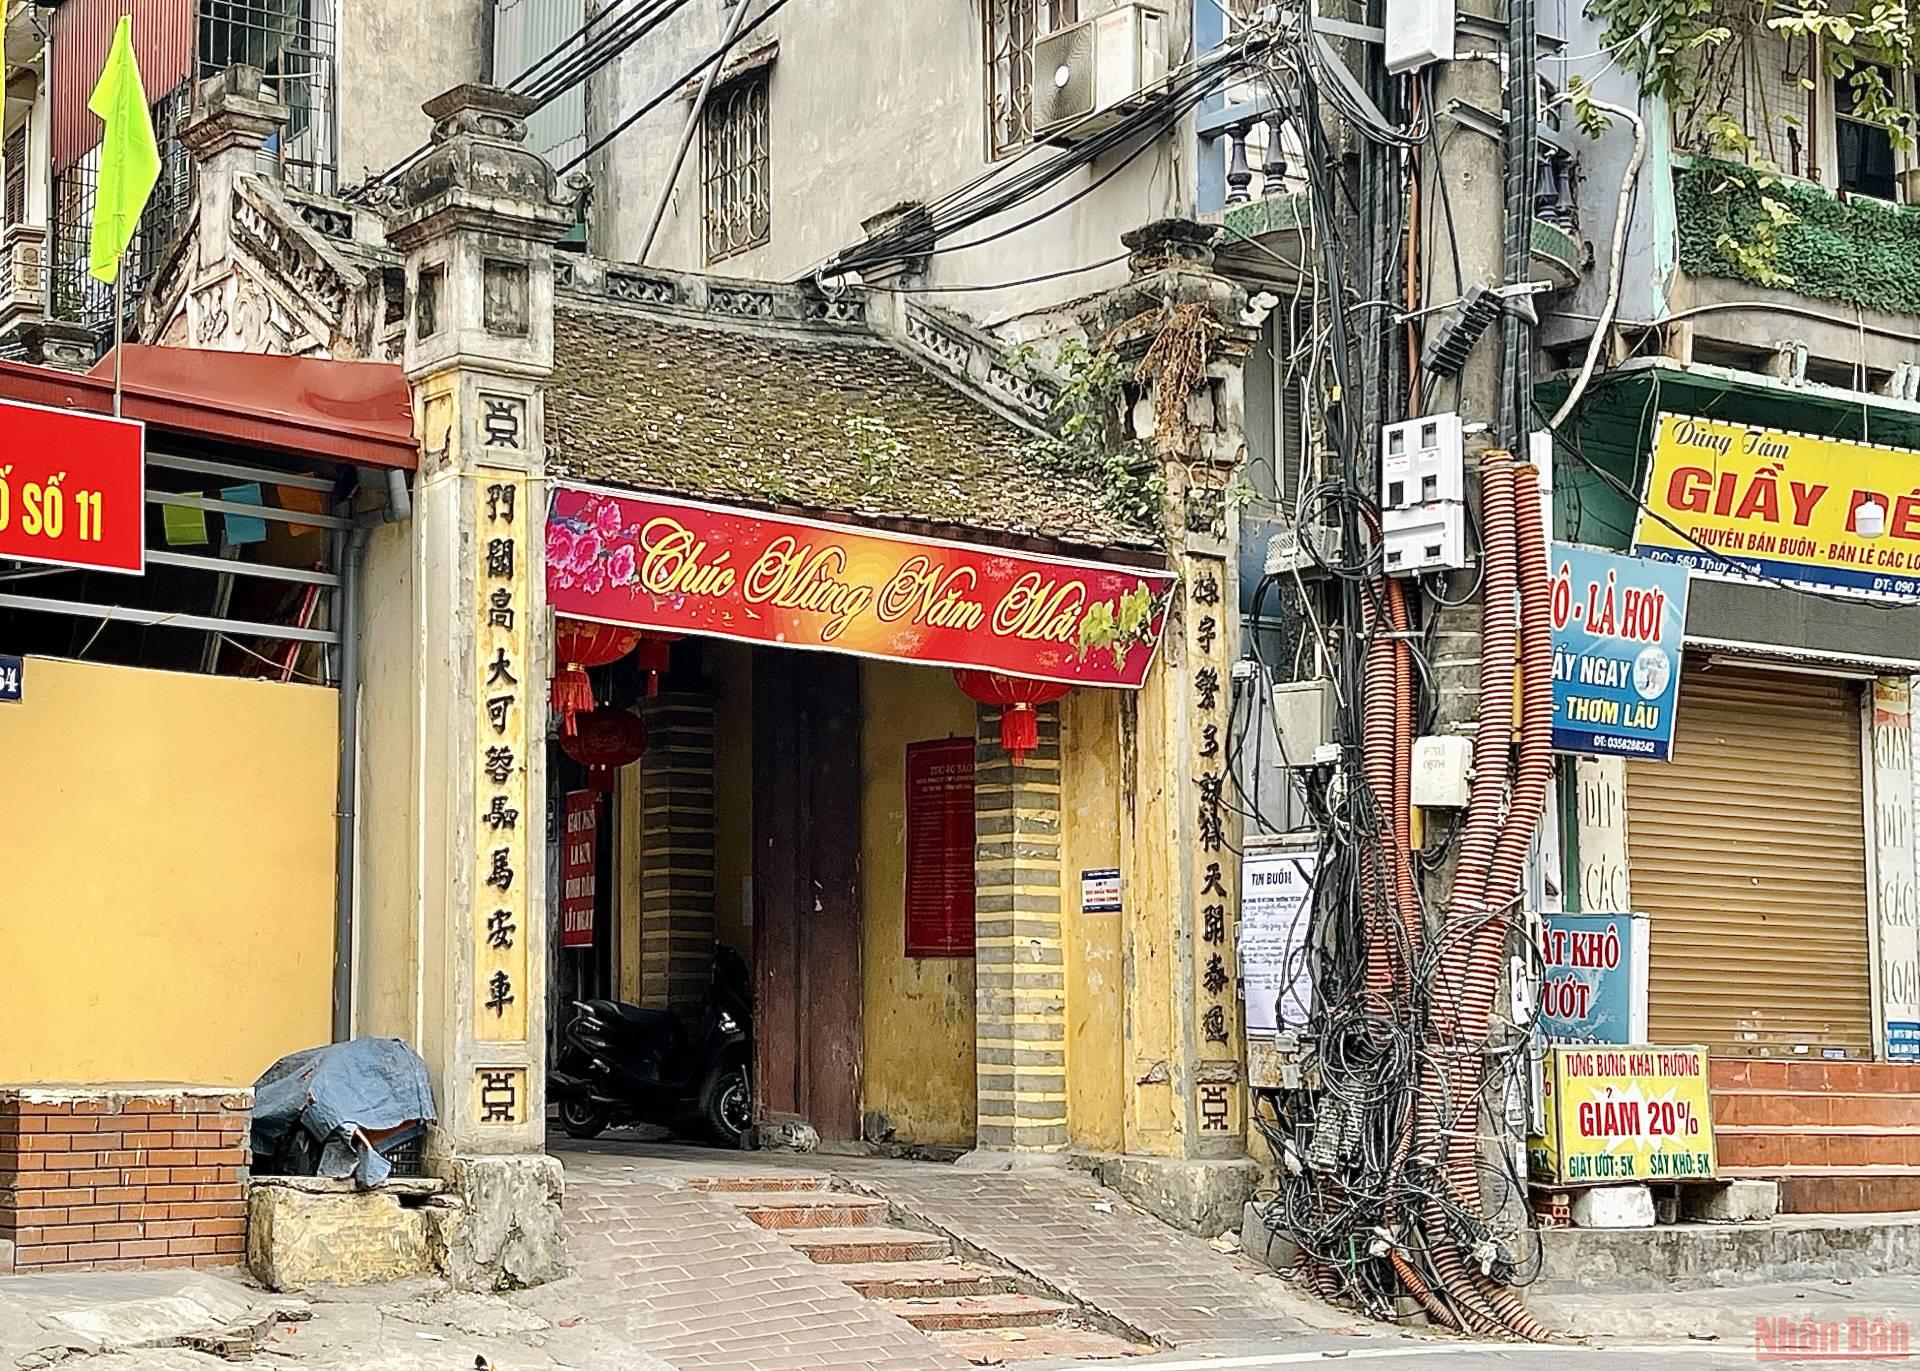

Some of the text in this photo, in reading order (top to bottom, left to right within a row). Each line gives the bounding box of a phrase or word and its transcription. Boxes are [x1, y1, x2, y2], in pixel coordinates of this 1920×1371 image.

[22, 472, 66, 538] SỐ
[76, 490, 102, 541] 11
[1666, 463, 1830, 528] GIẦY
[1747, 531, 1777, 553] BÁN
[1779, 536, 1817, 558] BUÔN
[1828, 541, 1857, 563] BÁN
[1858, 542, 1875, 565] LẺ
[1877, 547, 1904, 568] CÁC
[641, 517, 1087, 643] Chúc Mừng Năm Mới
[1621, 588, 1665, 641] HƠI
[1580, 656, 1631, 688] NGAY
[1566, 695, 1619, 725] THƠM
[1623, 701, 1659, 730] LÂU
[1571, 925, 1619, 968] KHÔ
[1629, 1053, 1655, 1077] KHAI
[1579, 1087, 1699, 1137] GIẢM 20%
[1621, 1154, 1635, 1176] 5K
[1650, 1146, 1670, 1175] SẤY
[1697, 1153, 1711, 1175] 5K
